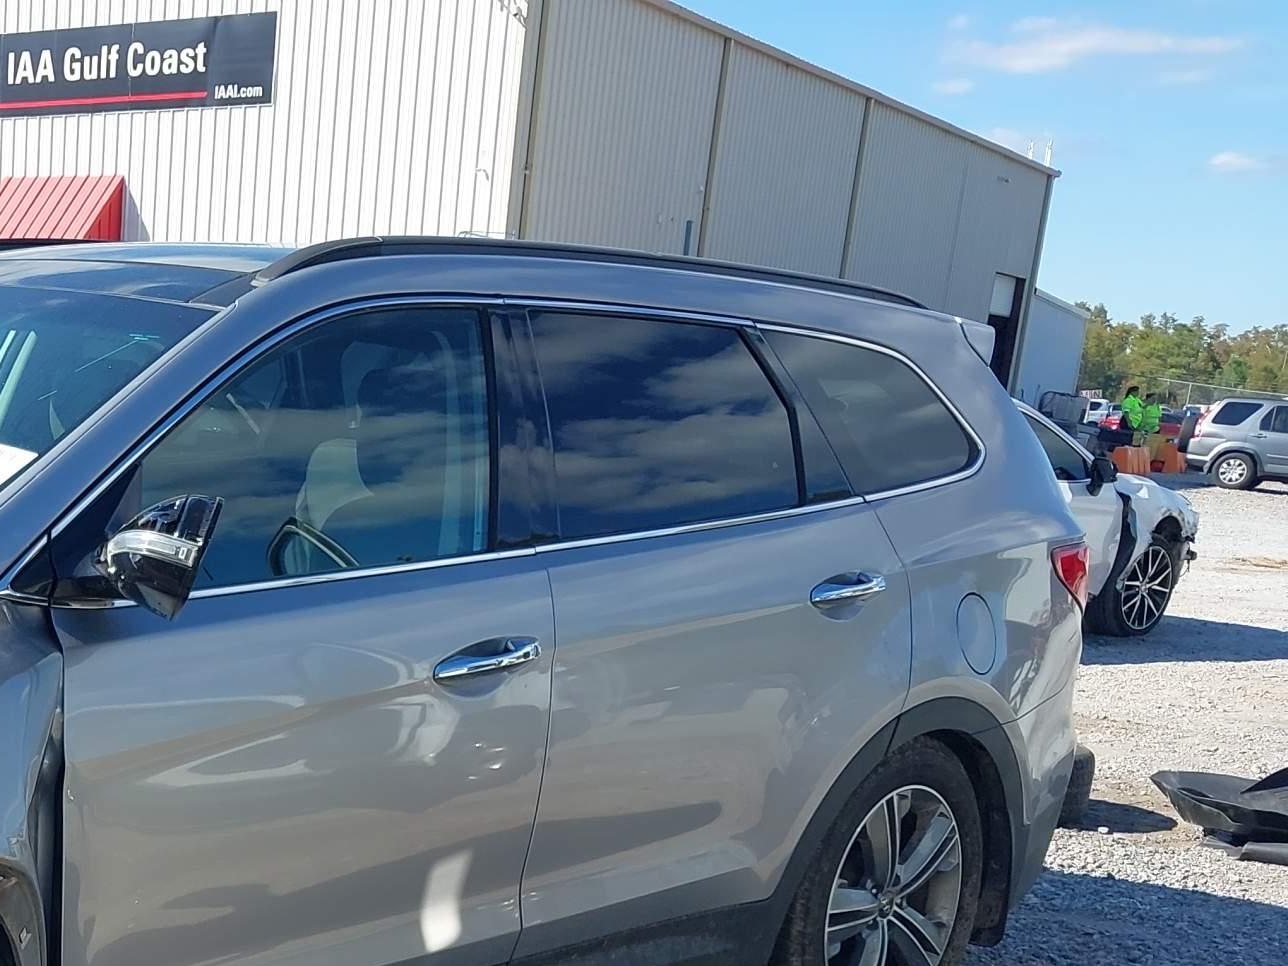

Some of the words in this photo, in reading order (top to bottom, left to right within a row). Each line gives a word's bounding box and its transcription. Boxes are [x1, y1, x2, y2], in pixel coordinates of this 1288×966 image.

[6, 48, 55, 86] IAA
[63, 44, 121, 82] Gulf
[126, 41, 207, 78] Coast
[214, 84, 263, 99] IAAI.com
